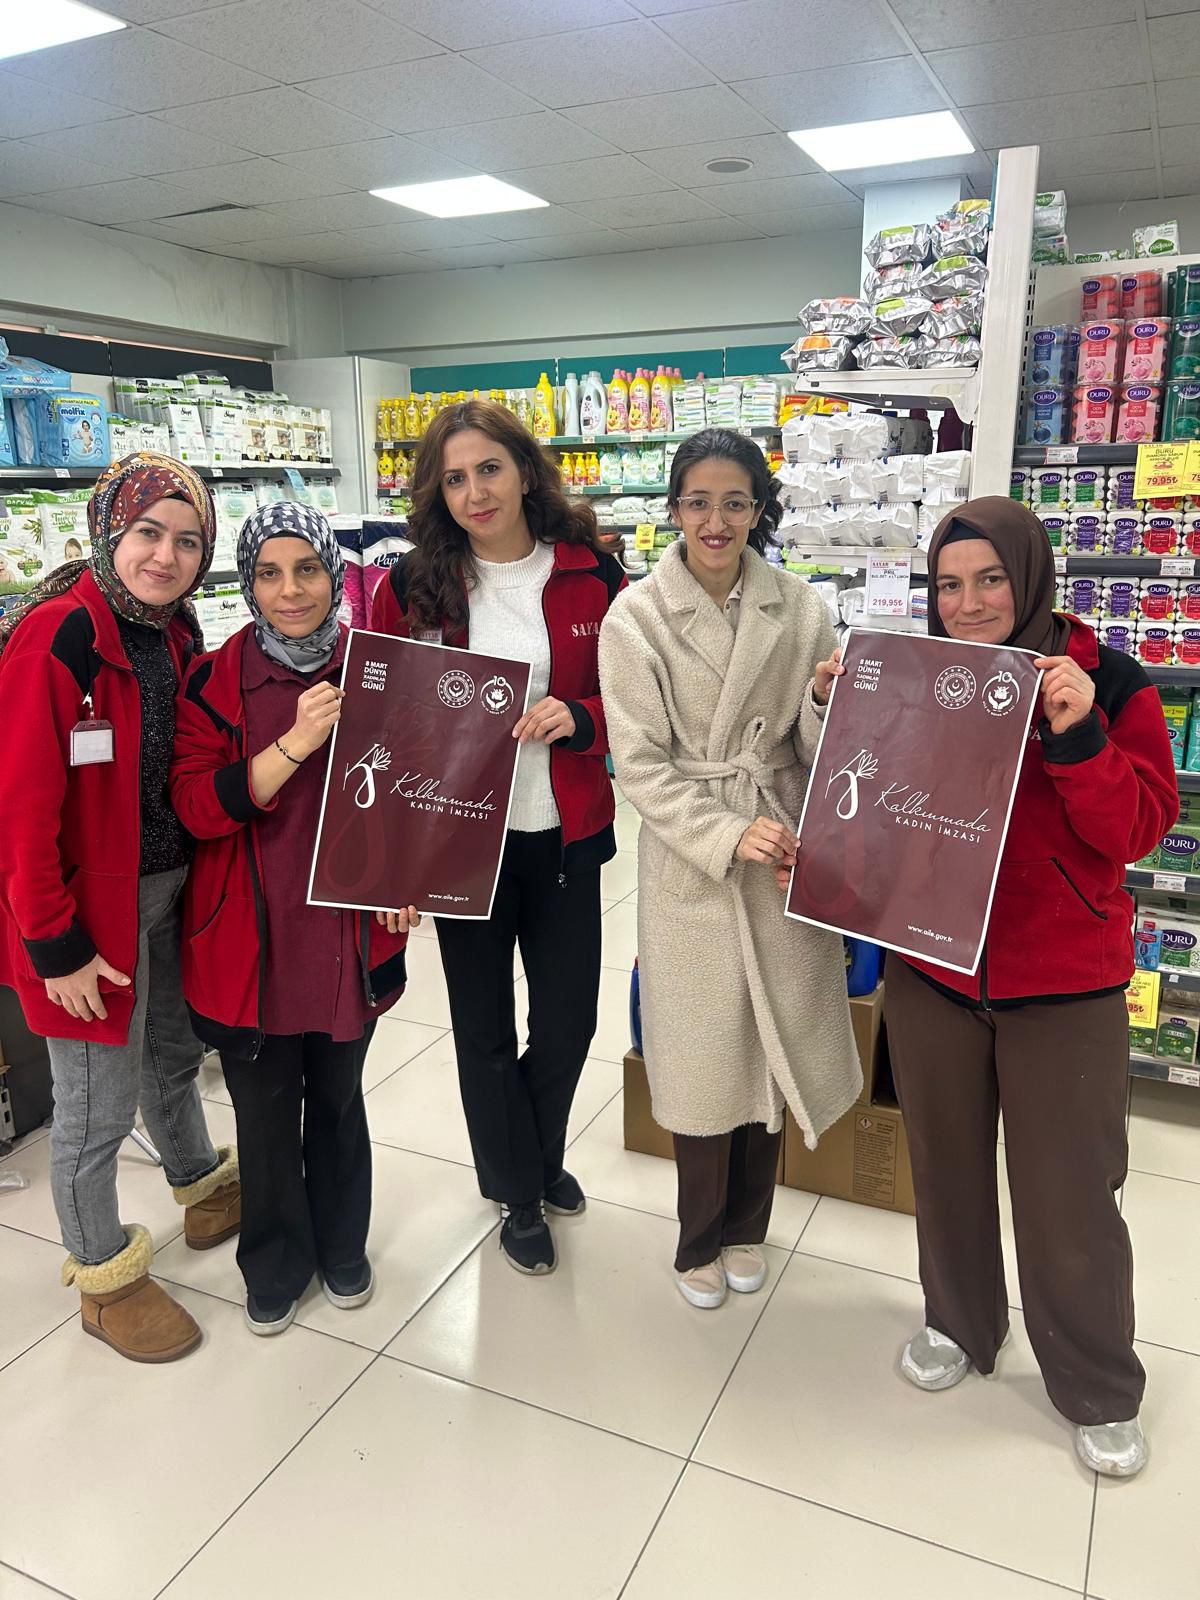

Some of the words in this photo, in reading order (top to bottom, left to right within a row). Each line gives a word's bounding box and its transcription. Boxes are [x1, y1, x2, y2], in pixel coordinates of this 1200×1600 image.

[1089, 329, 1110, 337] DURU
[1136, 326, 1157, 335] DURU
[1035, 333, 1055, 342] DURU
[1129, 389, 1150, 397] DURU
[1036, 394, 1056, 402] DURU
[60, 406, 86, 416] molfix
[1041, 474, 1061, 482] DURU
[1076, 473, 1096, 481] DURU
[1119, 473, 1134, 481] DUR
[1044, 519, 1064, 527] DURU
[1078, 518, 1098, 526] DURU
[1116, 520, 1137, 528] DURU
[1152, 519, 1172, 527] DURU
[373, 553, 399, 568] Papi
[872, 598, 904, 607] 219,95₺
[571, 621, 601, 637] SAYA
[370, 661, 389, 669] MART
[865, 659, 883, 668] MART
[363, 666, 387, 677] DÜNYA
[857, 665, 881, 676] DÜNYA
[361, 680, 385, 692] GÜNÜ
[853, 680, 878, 692] GÜNÜ
[410, 801, 445, 813] KADIN
[450, 806, 489, 820] İMZASI
[895, 815, 932, 832] KADIN
[938, 826, 981, 844] İMZASI
[1163, 837, 1197, 850] DURU
[428, 893, 470, 902] www.aile.gov.tr
[907, 924, 953, 943] www.aile.gov.tr
[1162, 933, 1194, 946] DURU
[1127, 1004, 1145, 1013] 95₺
